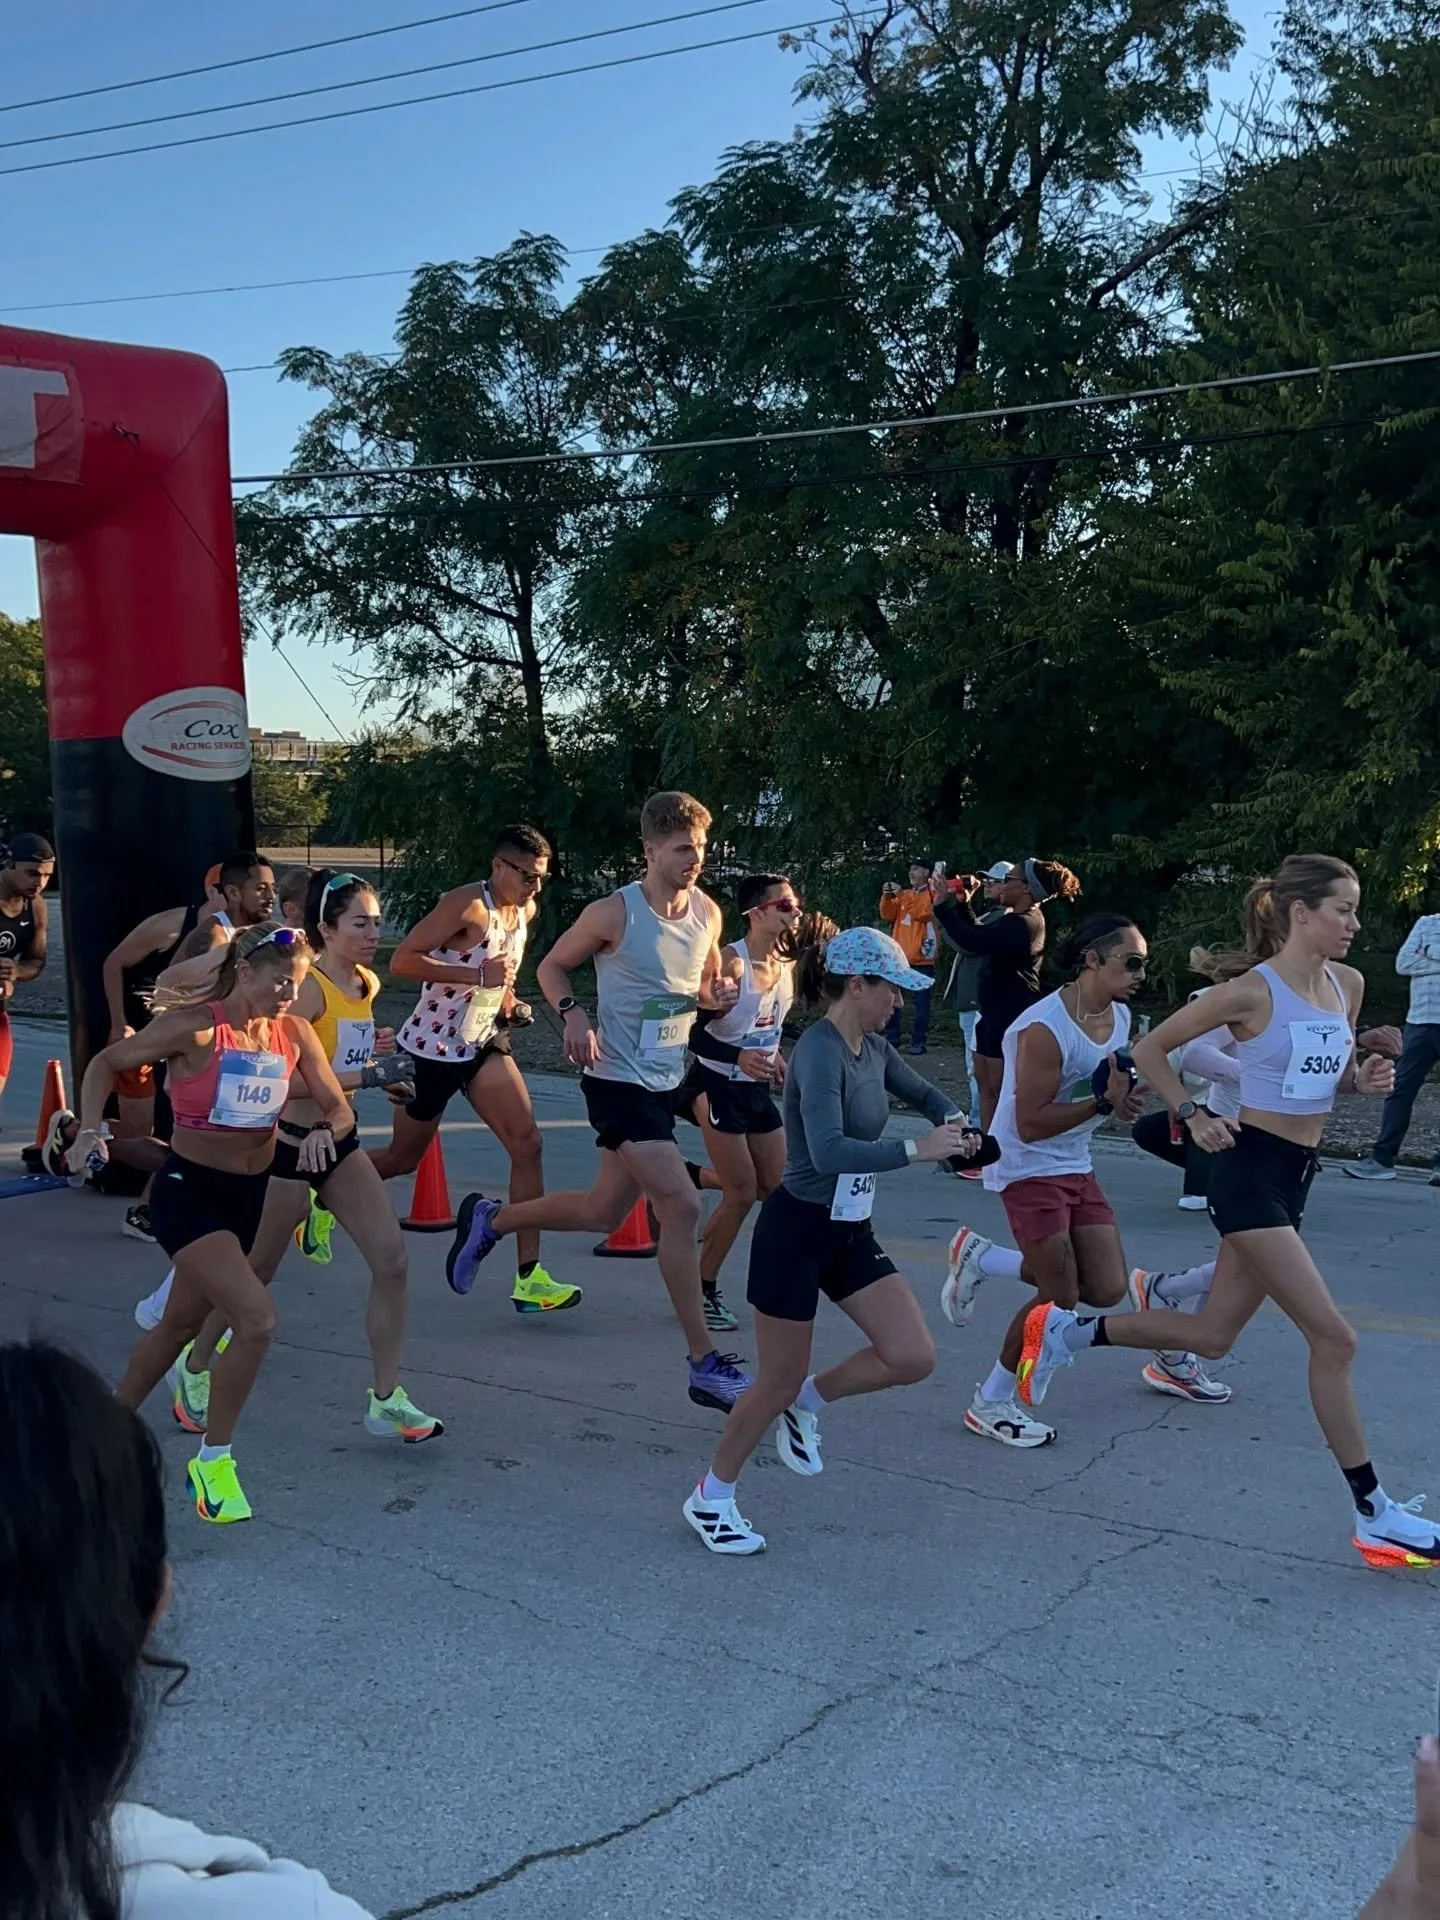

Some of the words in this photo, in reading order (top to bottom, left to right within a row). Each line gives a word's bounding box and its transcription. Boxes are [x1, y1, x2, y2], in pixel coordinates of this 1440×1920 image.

[184, 719, 240, 739] Cox
[171, 742, 212, 751] RACING
[657, 1025, 678, 1041] 130
[1300, 1055, 1341, 1075] 5306
[236, 1083, 272, 1105] 1148
